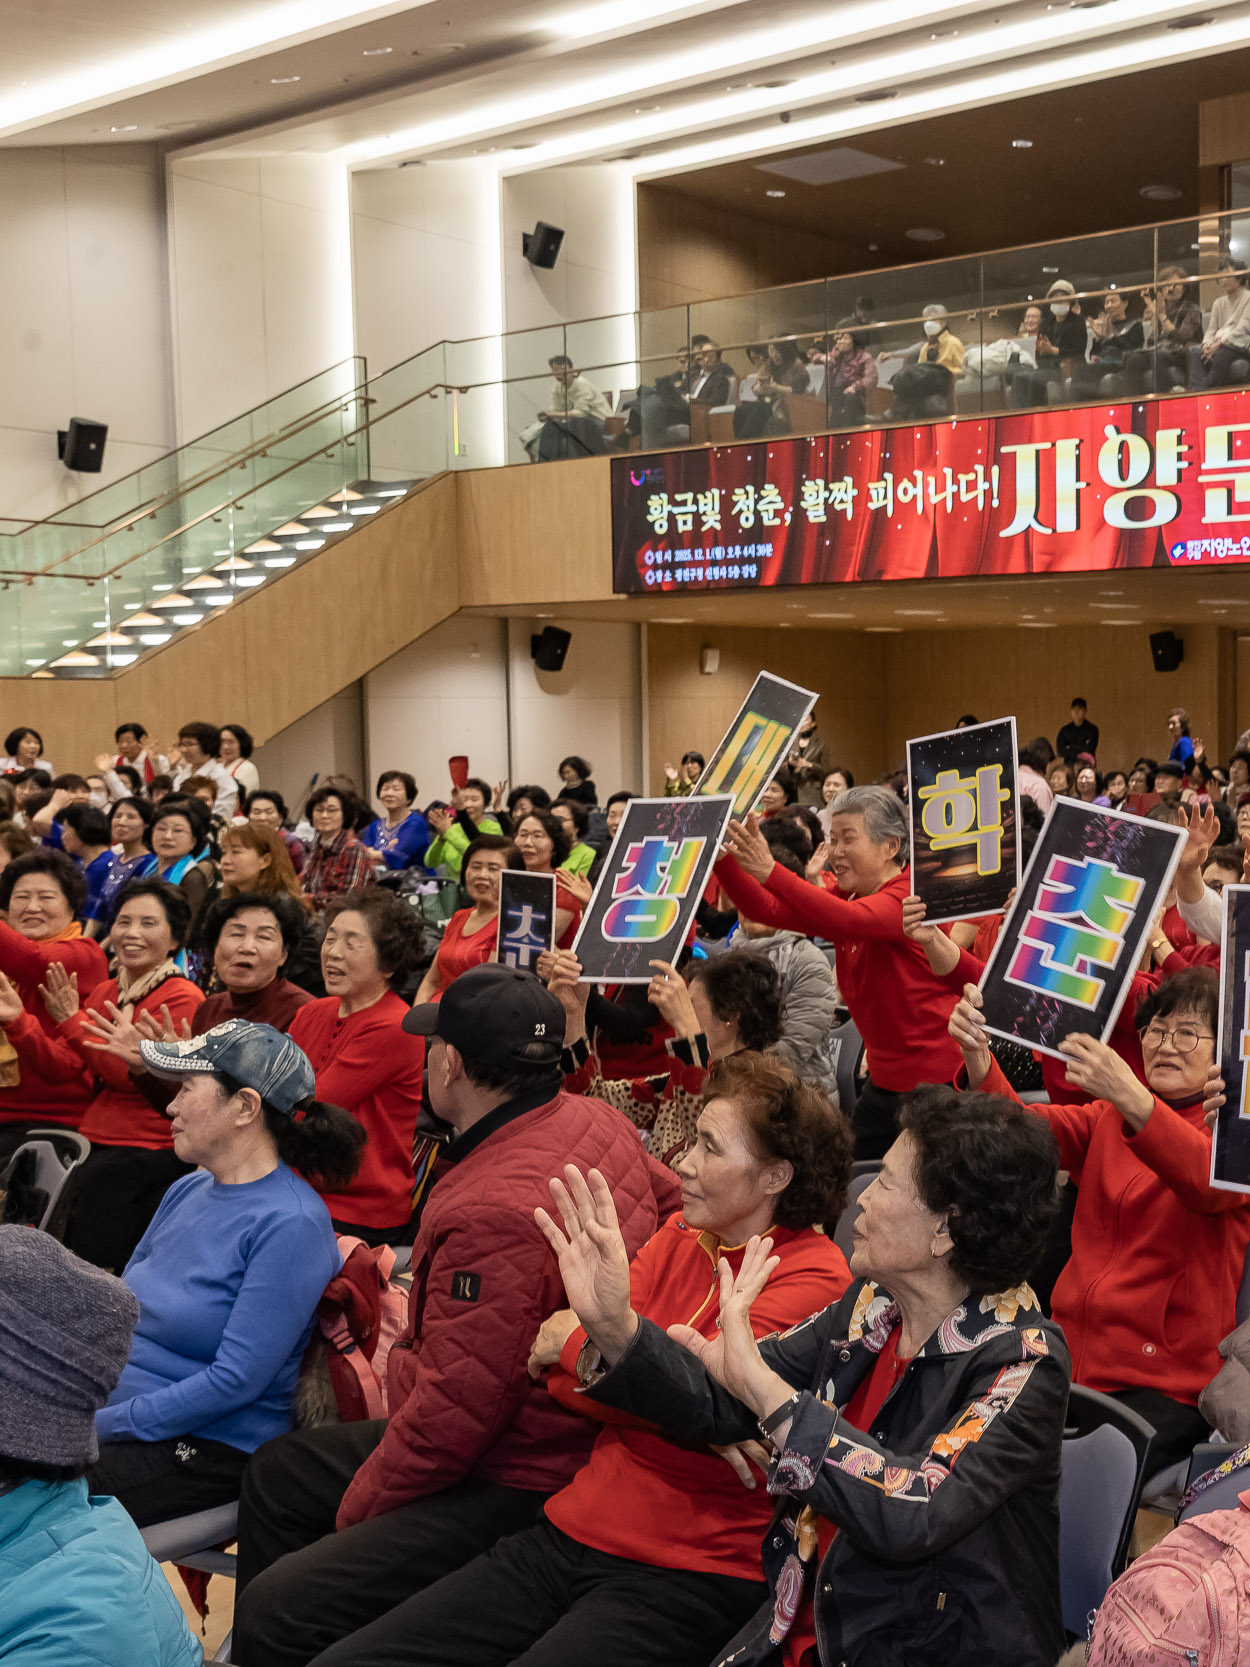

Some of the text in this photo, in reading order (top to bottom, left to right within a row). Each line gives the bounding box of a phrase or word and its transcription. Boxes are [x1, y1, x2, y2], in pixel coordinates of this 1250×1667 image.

[646, 463, 1001, 535] 황금빛 청춘, 활짝 피어나다!
[919, 763, 1010, 877] 학
[601, 835, 708, 943] 청
[1003, 853, 1147, 1012] 춘
[534, 1023, 546, 1036] 23
